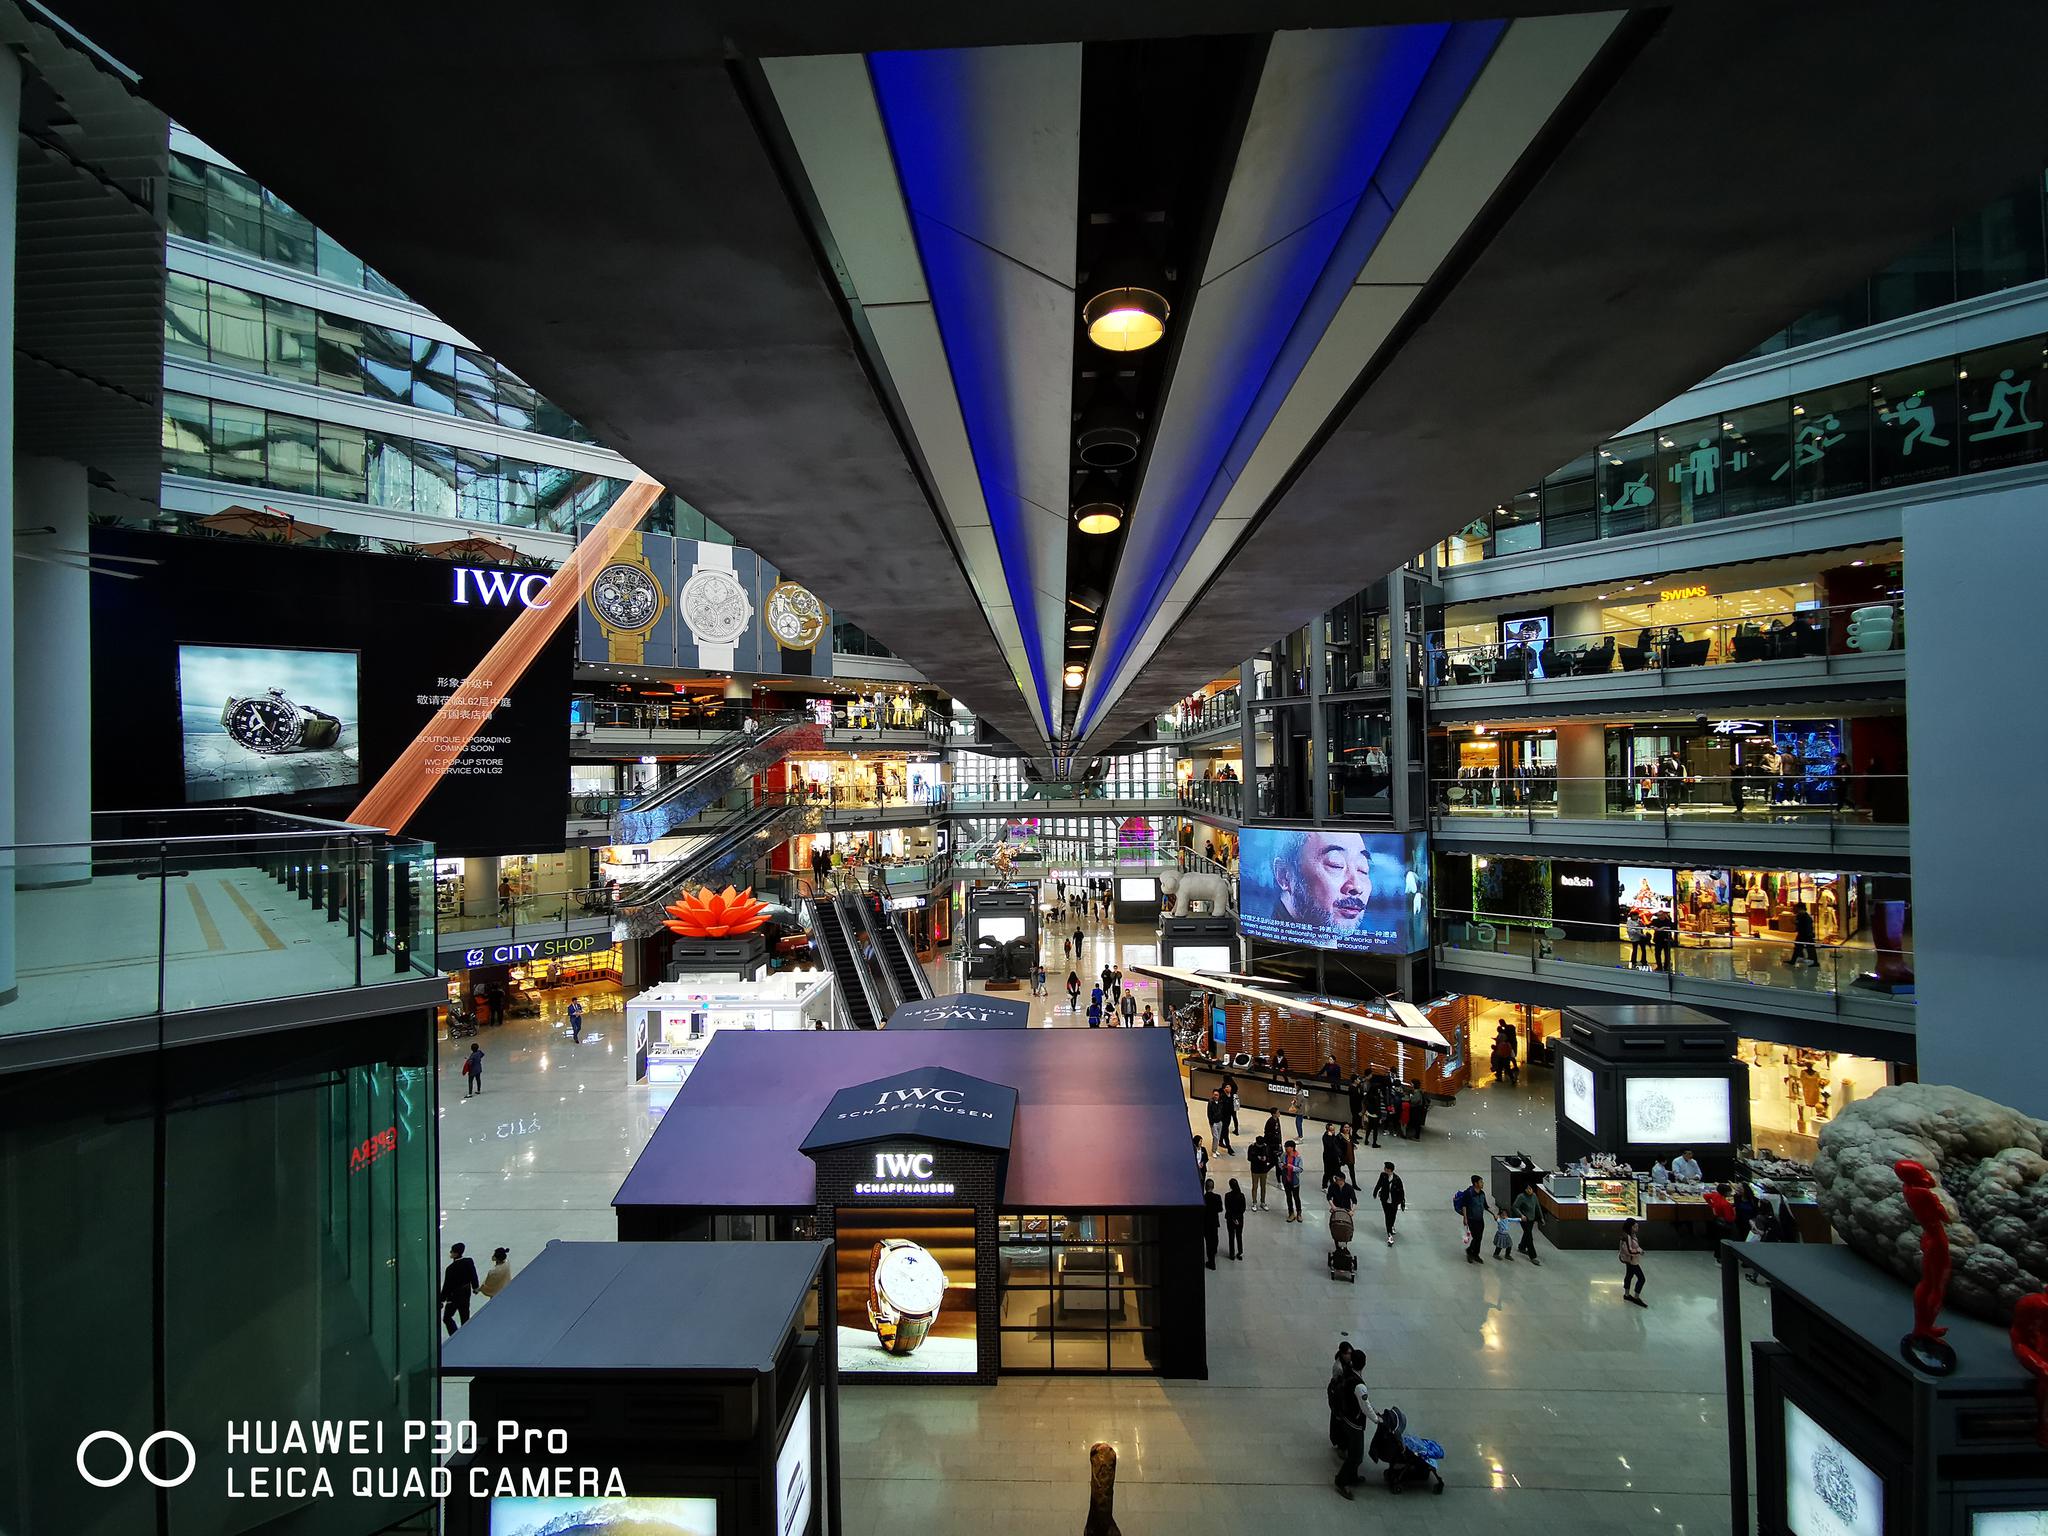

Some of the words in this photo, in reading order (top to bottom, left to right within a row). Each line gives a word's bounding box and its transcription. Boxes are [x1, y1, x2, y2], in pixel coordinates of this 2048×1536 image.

[453, 568, 551, 609] IWC
[1661, 586, 1706, 601] SWIMS
[462, 736, 511, 744] UPGRADING
[434, 744, 469, 752] COMING
[424, 758, 441, 766] IWC
[442, 758, 474, 766] POP-UP
[436, 767, 471, 775] SERVICE
[472, 767, 485, 775] ON
[487, 767, 503, 775] LG2
[1560, 874, 1594, 887] ba&sh
[1344, 936, 1373, 944] artworks
[1374, 937, 1389, 945] that
[494, 942, 540, 961] CITY
[544, 937, 595, 955] SHOP
[1337, 943, 1371, 951] encounter
[923, 1010, 990, 1021] IWC
[875, 1088, 965, 1105] IWC
[837, 1103, 993, 1119] SCHAFFHAUSEN
[875, 1153, 934, 1180] IWC
[855, 1183, 955, 1195] SCHAFFHAUSEN
